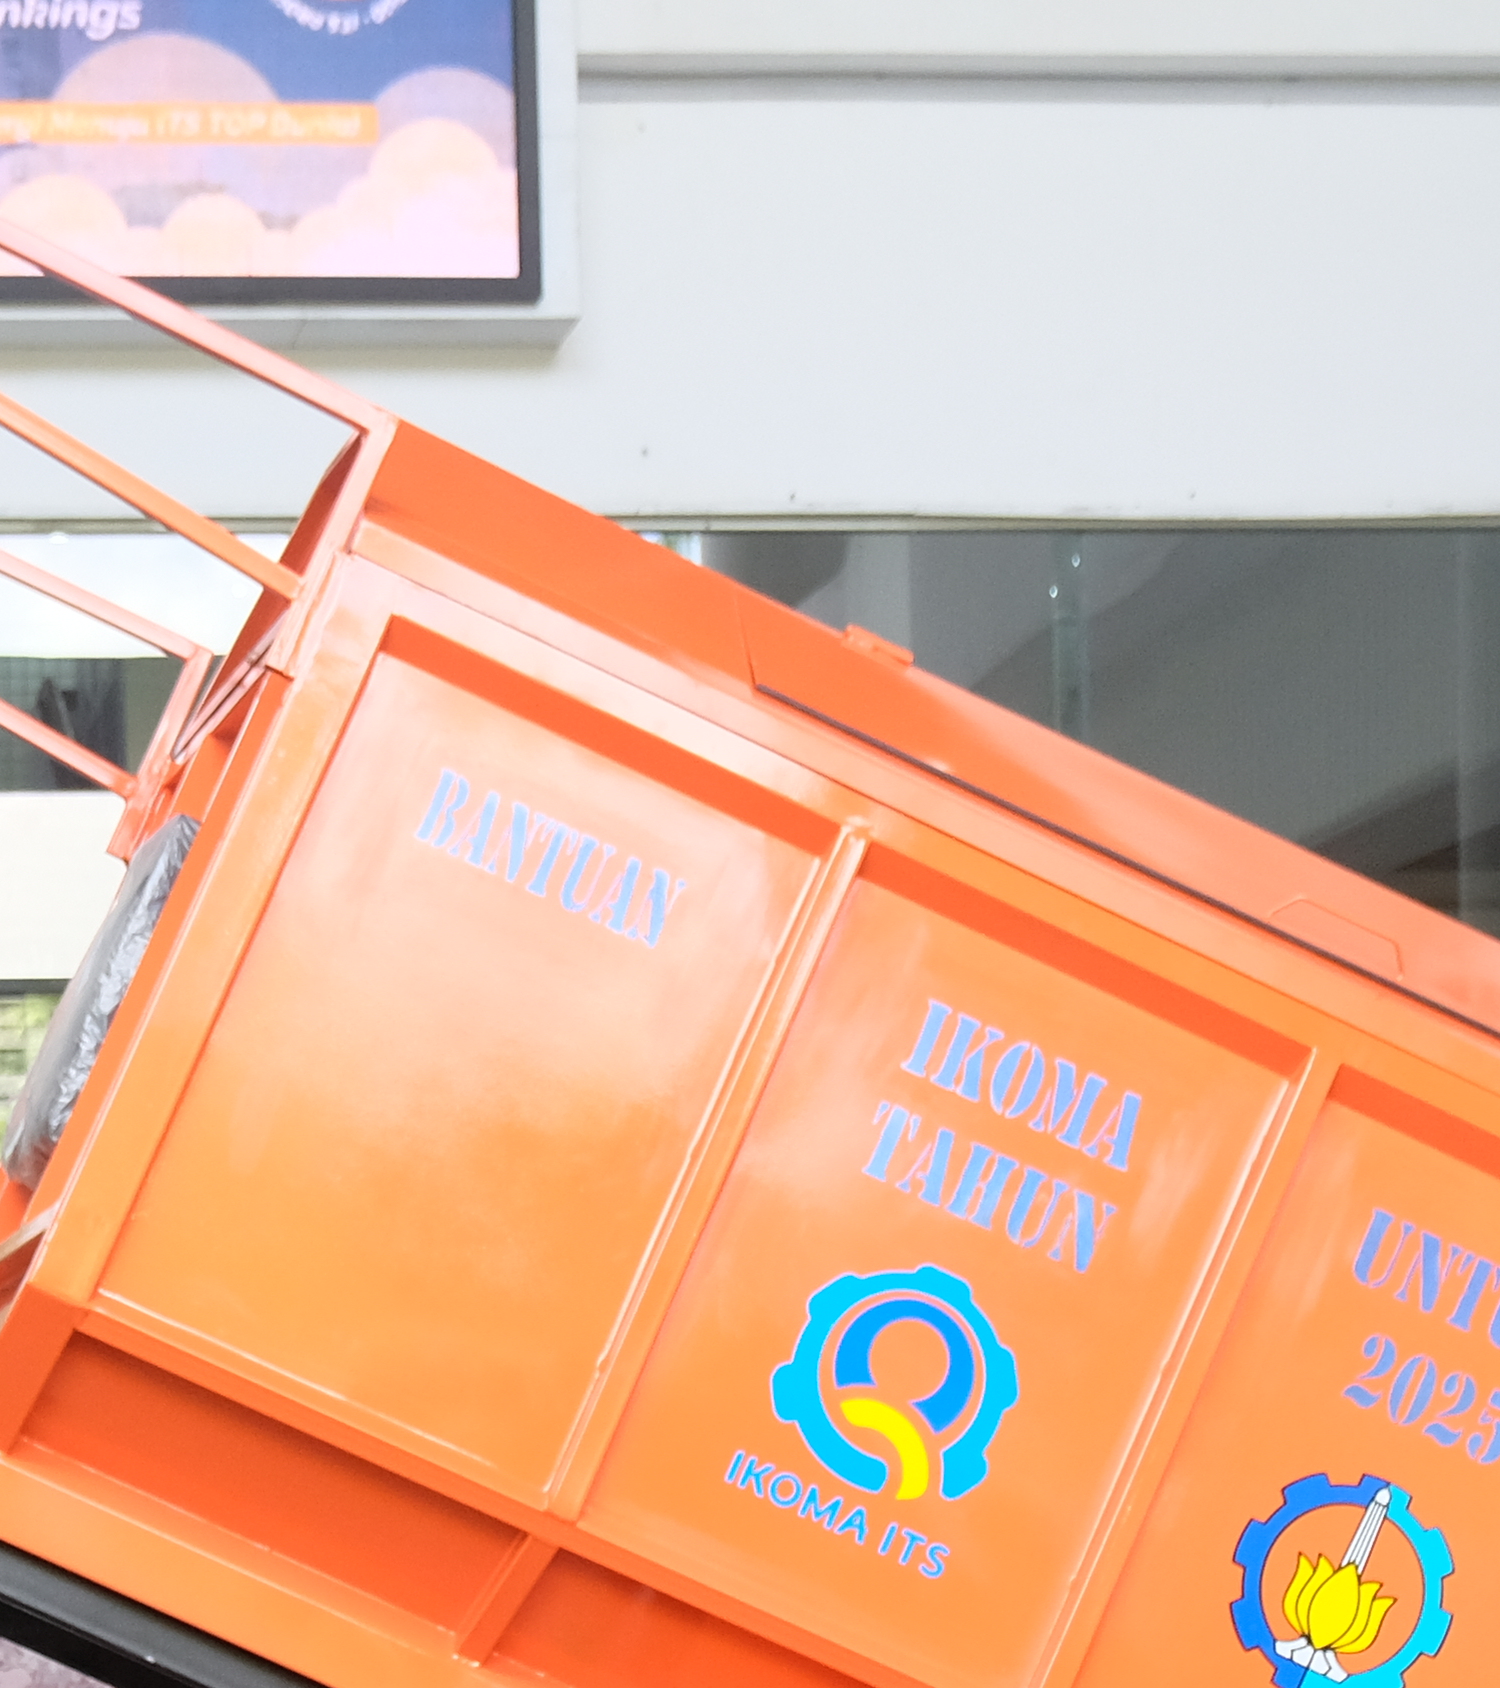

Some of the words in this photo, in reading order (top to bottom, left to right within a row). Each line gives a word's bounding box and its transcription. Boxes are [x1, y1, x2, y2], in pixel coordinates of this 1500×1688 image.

[413, 767, 688, 949] BANTUAN
[900, 998, 1143, 1172] IKOMA
[861, 1100, 1117, 1274] TAHUN
[724, 1450, 869, 1545] IKOMA
[878, 1522, 951, 1578] ITS
